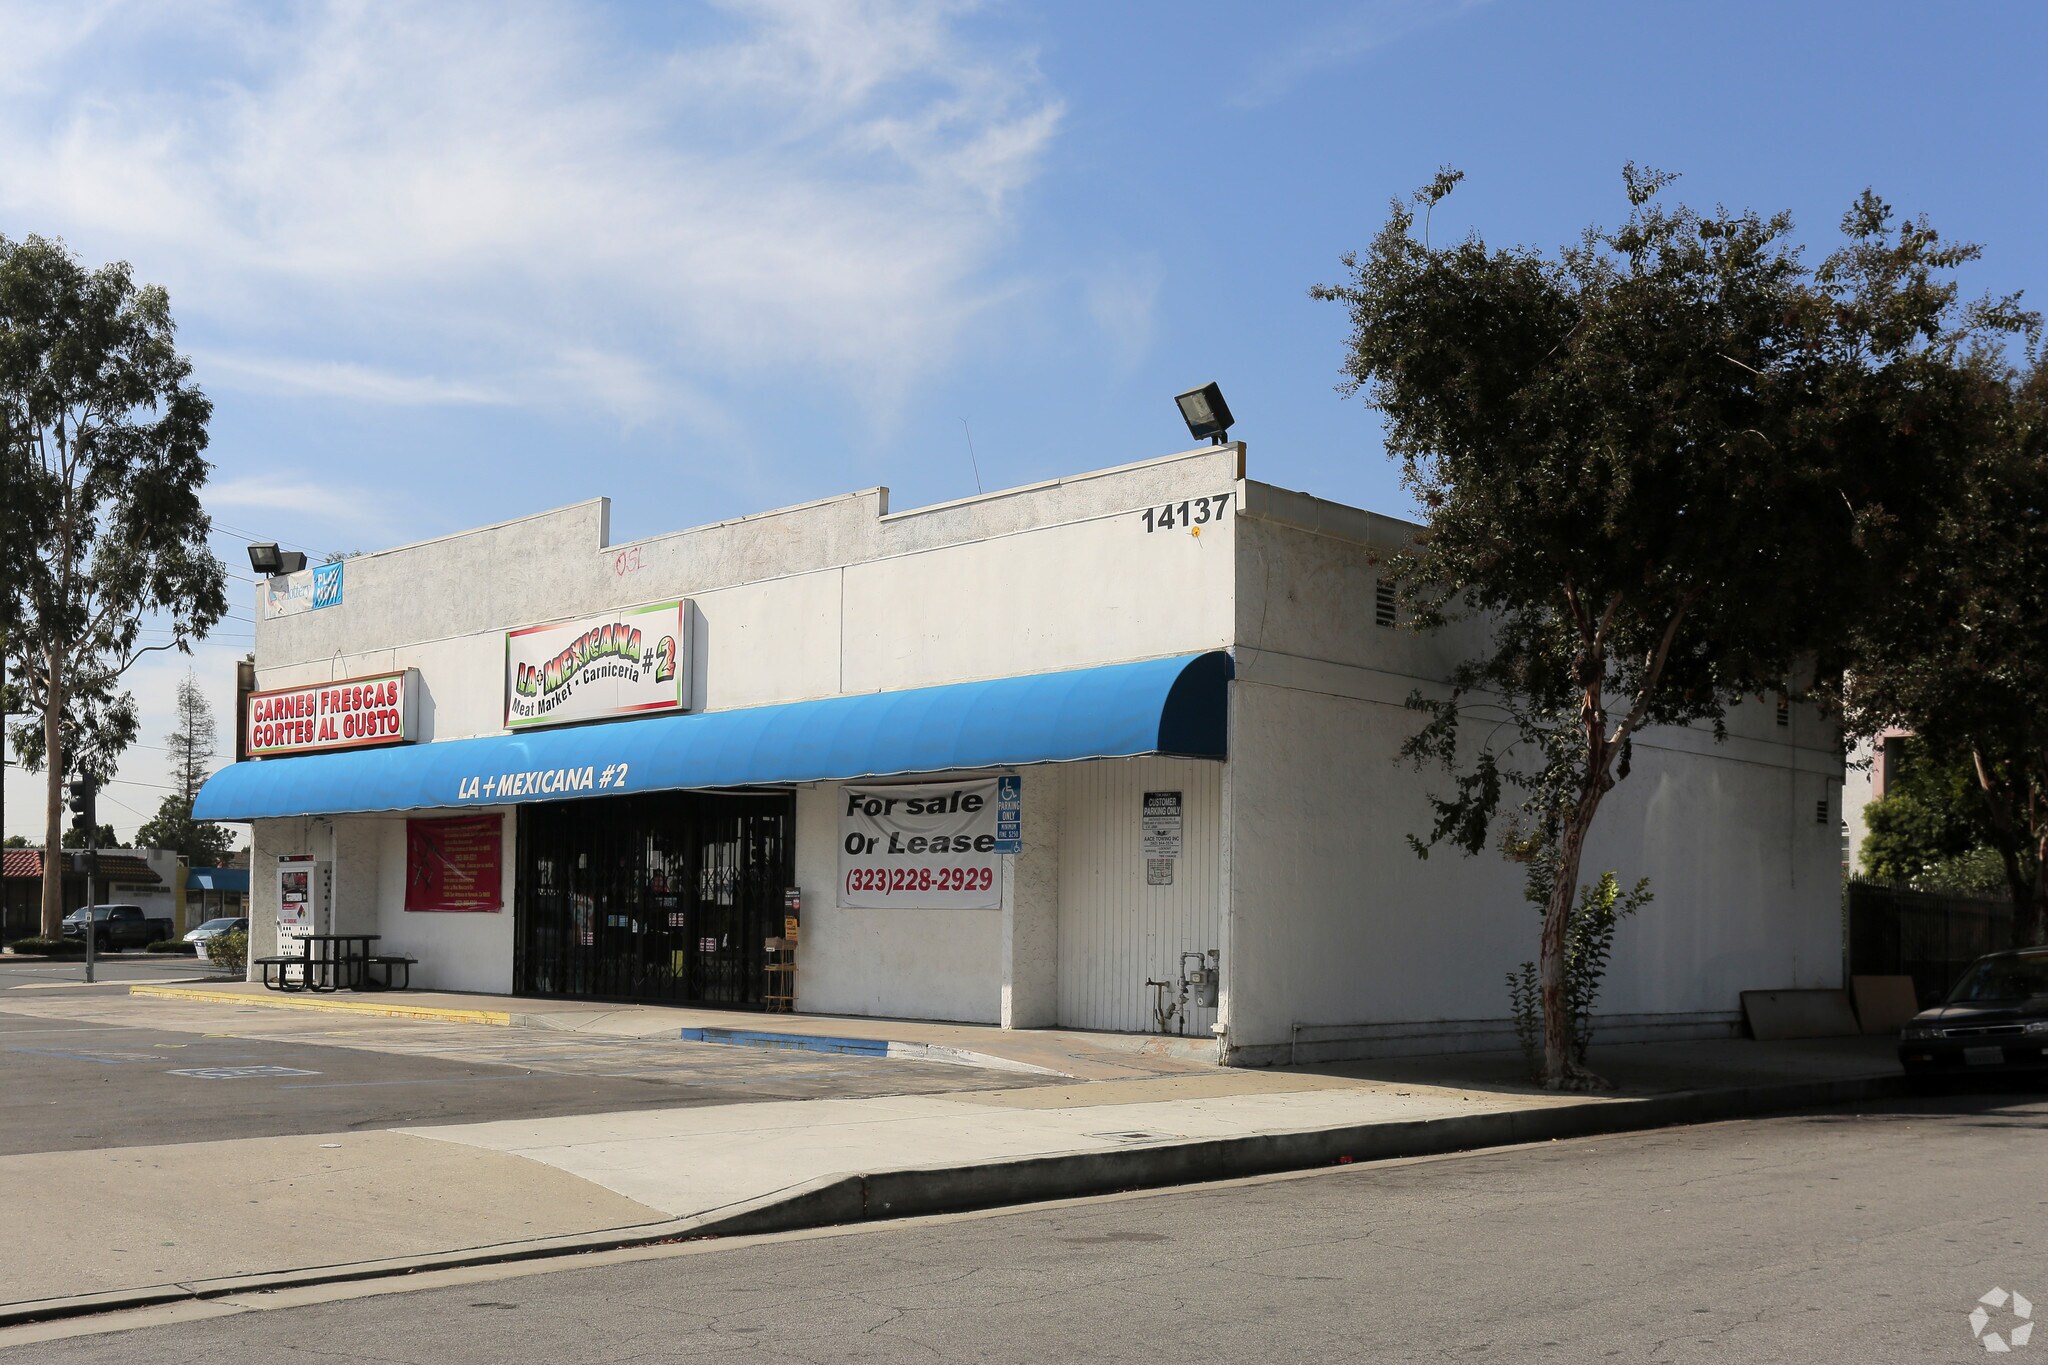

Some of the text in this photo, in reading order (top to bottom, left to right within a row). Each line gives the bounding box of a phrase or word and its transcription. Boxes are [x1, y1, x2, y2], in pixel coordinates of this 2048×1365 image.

[1142, 494, 1230, 533] 14137
[254, 681, 398, 722] CARNES FRESCAS
[512, 662, 639, 717] Meat Market Carniceria
[253, 708, 400, 747] CORTES AL GUSTO
[599, 763, 628, 788] #2
[846, 790, 984, 817] For sale
[998, 801, 1019, 811] PARKING
[1143, 806, 1180, 816] PARKING ONLY
[1148, 797, 1177, 807] CUSTOMER
[1002, 811, 1015, 821] ONLY
[844, 831, 996, 855] Or Lease
[846, 867, 993, 895] (323)228-2929
